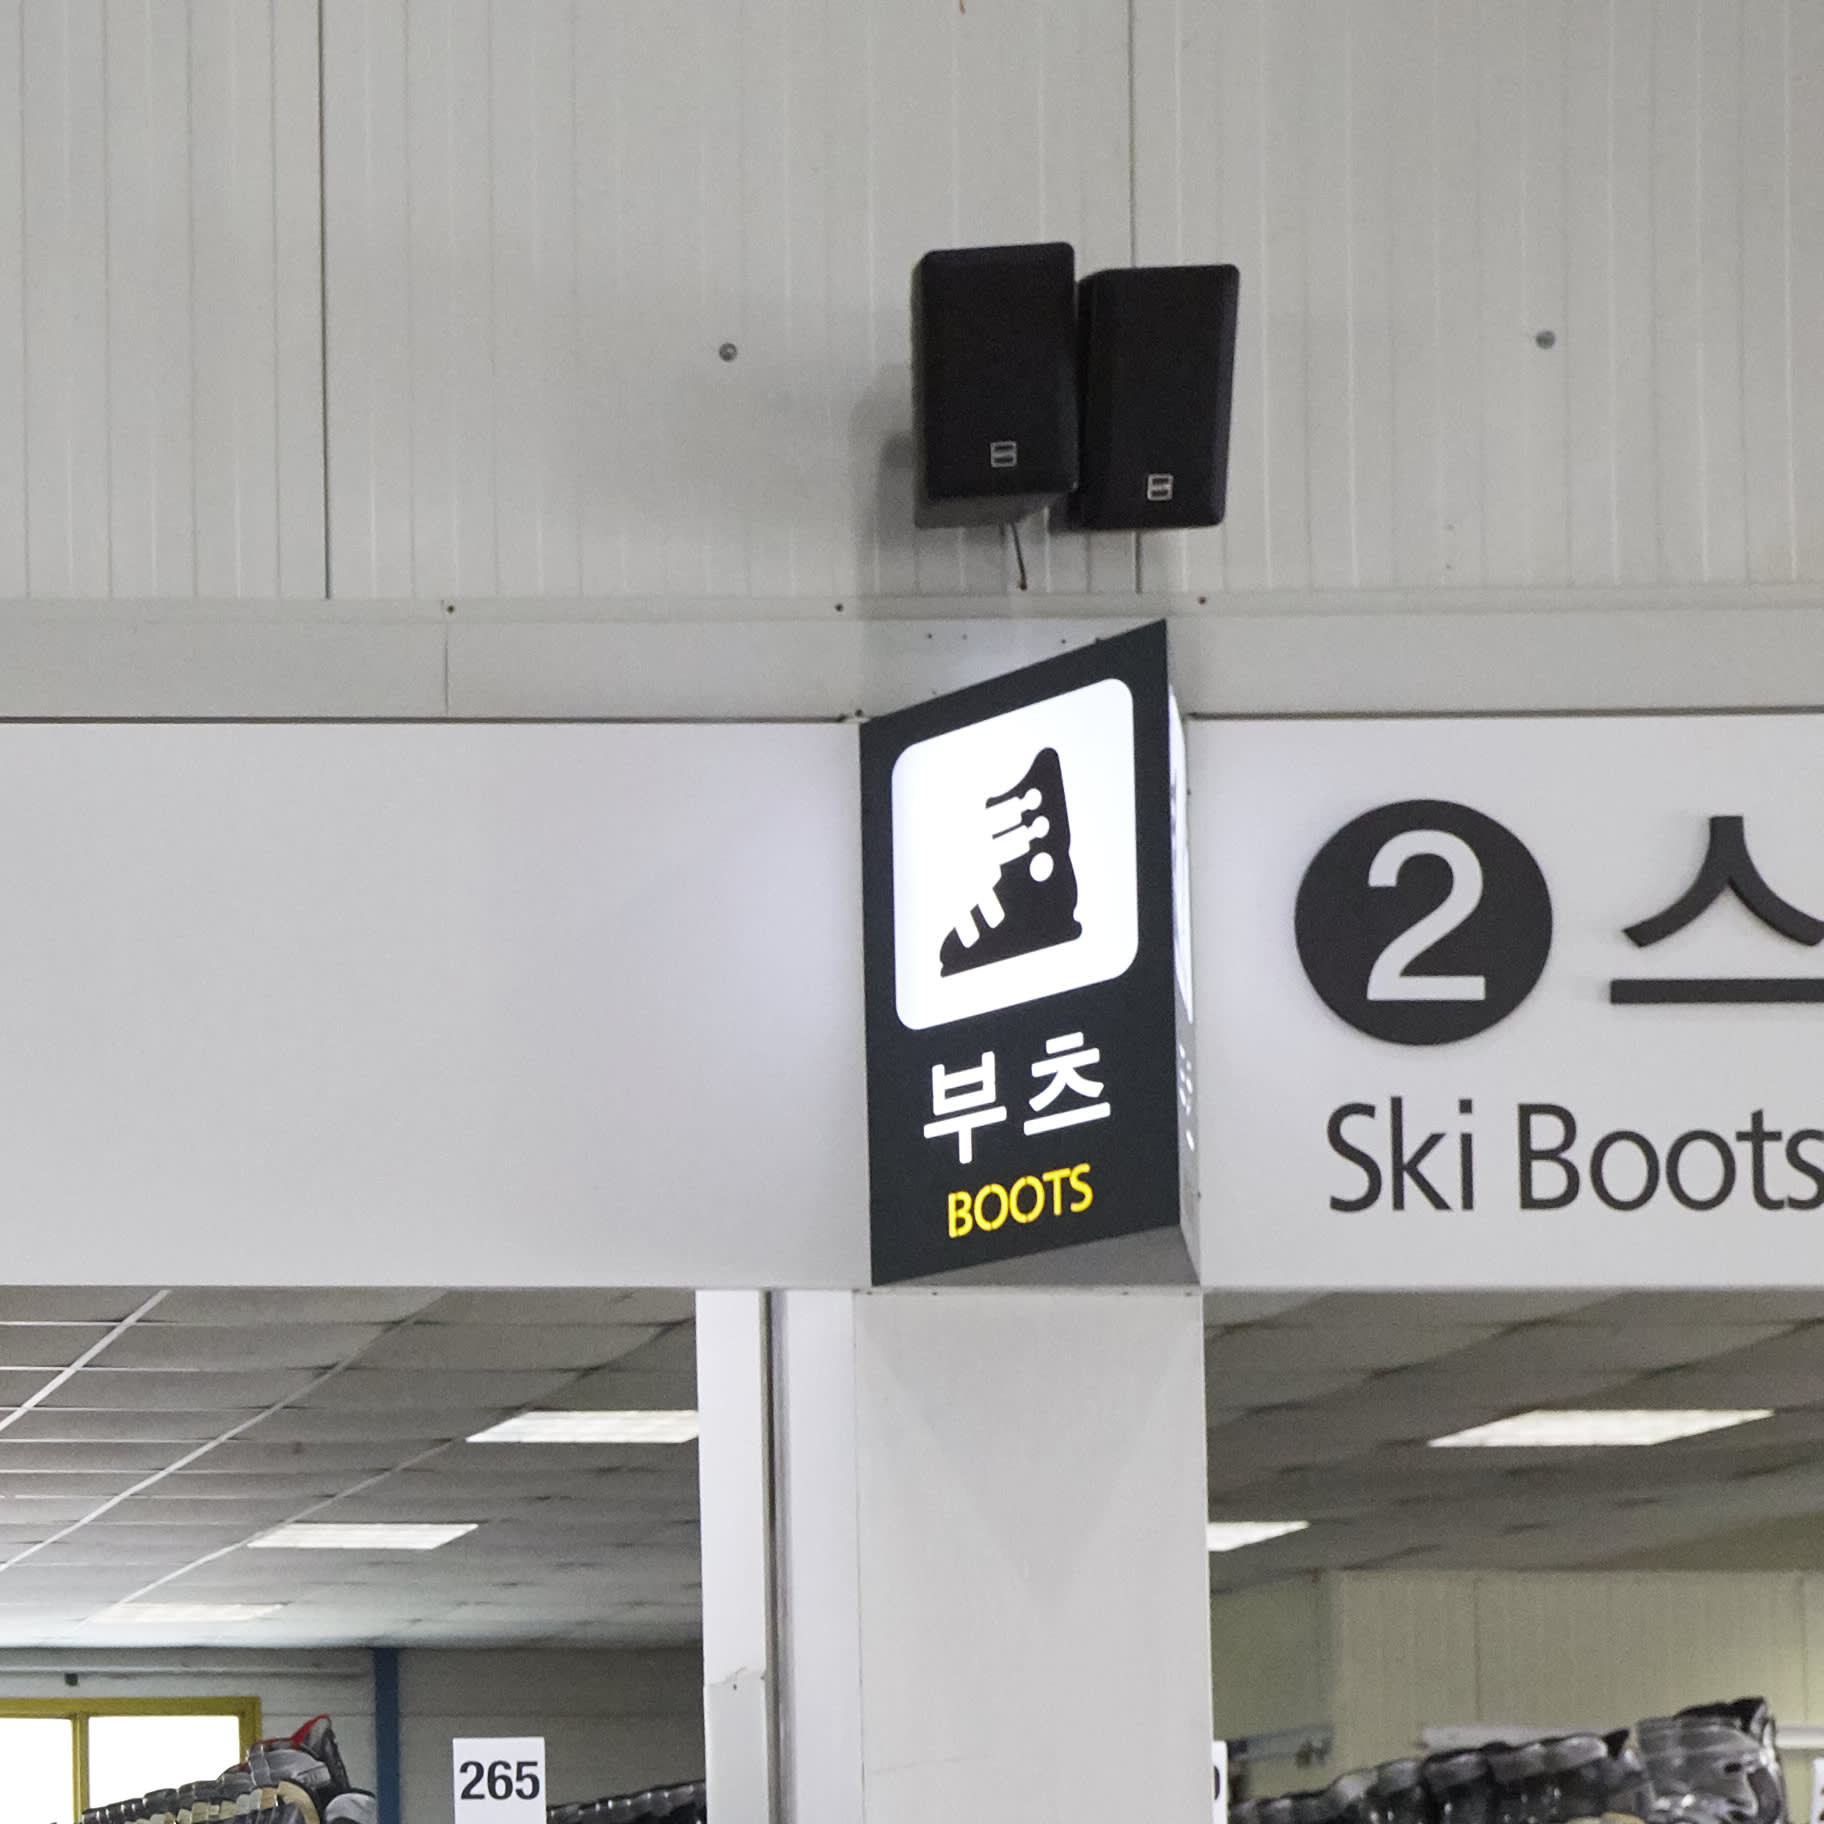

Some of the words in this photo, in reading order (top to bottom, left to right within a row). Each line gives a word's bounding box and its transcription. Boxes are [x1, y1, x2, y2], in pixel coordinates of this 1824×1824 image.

[1367, 830, 1485, 1000] 2
[924, 1032, 1110, 1164] 부츠
[1327, 1097, 1473, 1212] Ski
[1520, 1101, 1824, 1212] Boots
[948, 1163, 1093, 1238] BOOTS
[460, 1761, 539, 1800] 265
